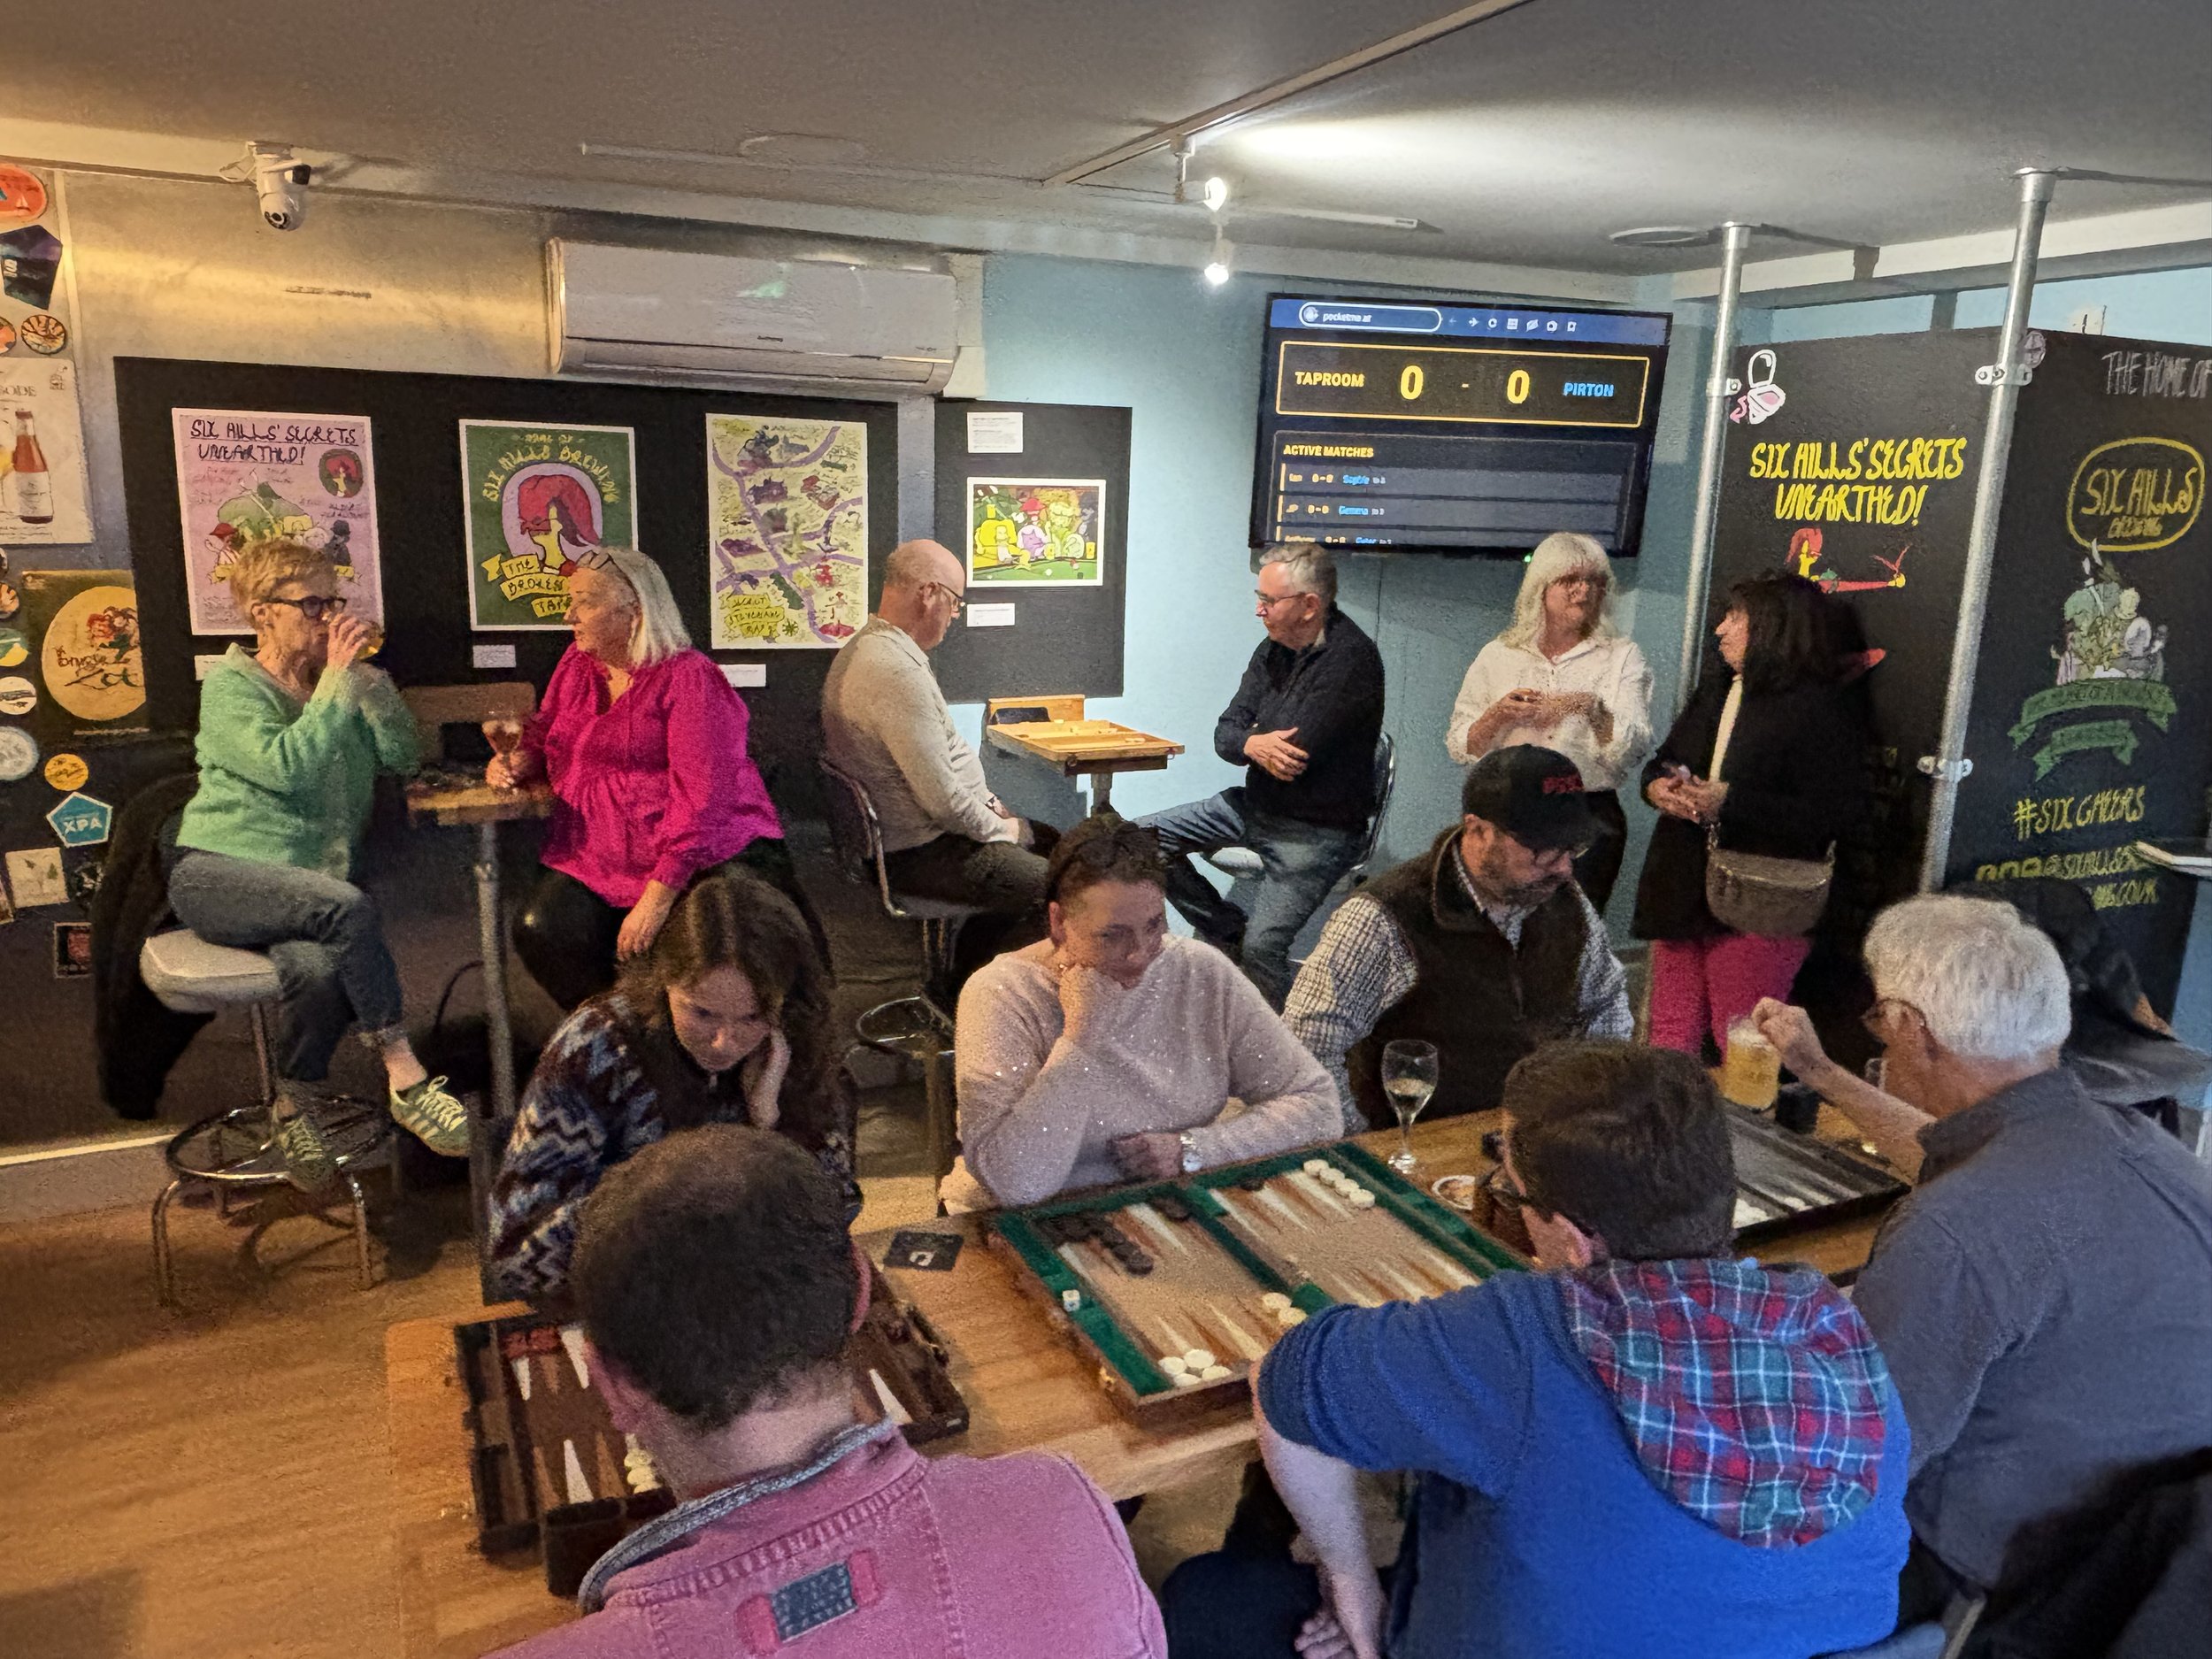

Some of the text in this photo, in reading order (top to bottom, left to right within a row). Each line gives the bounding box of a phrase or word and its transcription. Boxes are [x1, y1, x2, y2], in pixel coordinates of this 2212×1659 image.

[1294, 371, 1364, 388] TAPROOM
[1400, 365, 1424, 400] 0
[1507, 369, 1530, 404] 0
[1563, 381, 1615, 397] PIRTON
[2101, 350, 2142, 395] THE
[285, 425, 357, 444] SECRETS
[1283, 444, 1374, 458] ACTIVE MATCHES
[1749, 442, 1791, 479] SIX
[1865, 436, 1968, 480] SECRETS
[1774, 483, 1928, 526] UNEARTHED!
[2080, 468, 2127, 516] SIX
[63, 816, 103, 835] XPA
